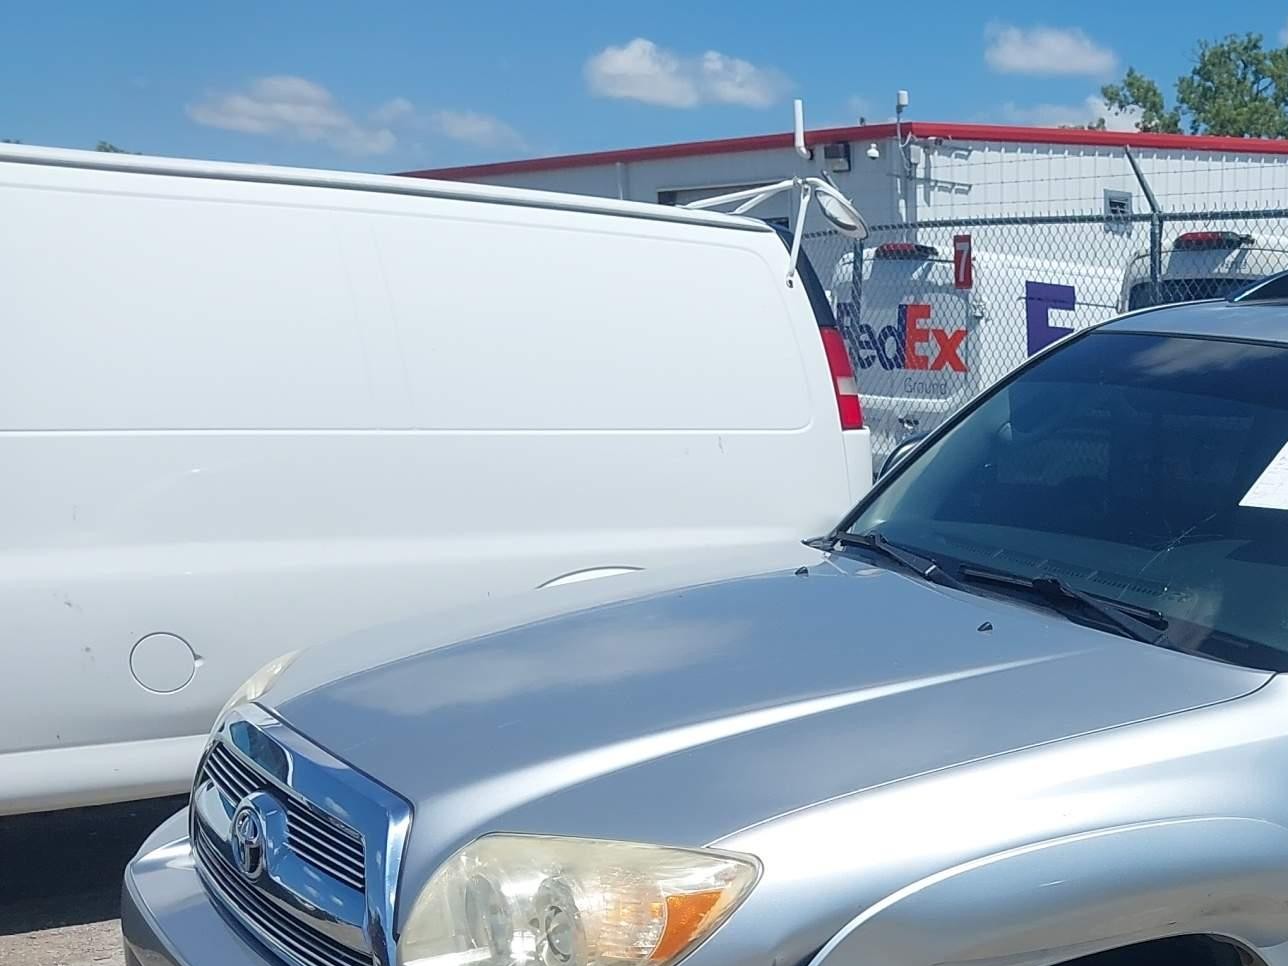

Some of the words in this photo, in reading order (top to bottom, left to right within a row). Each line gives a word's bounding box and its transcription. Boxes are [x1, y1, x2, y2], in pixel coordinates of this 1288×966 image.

[955, 241, 970, 283] 7
[837, 303, 970, 373] FedEx
[904, 377, 948, 395] Ground
